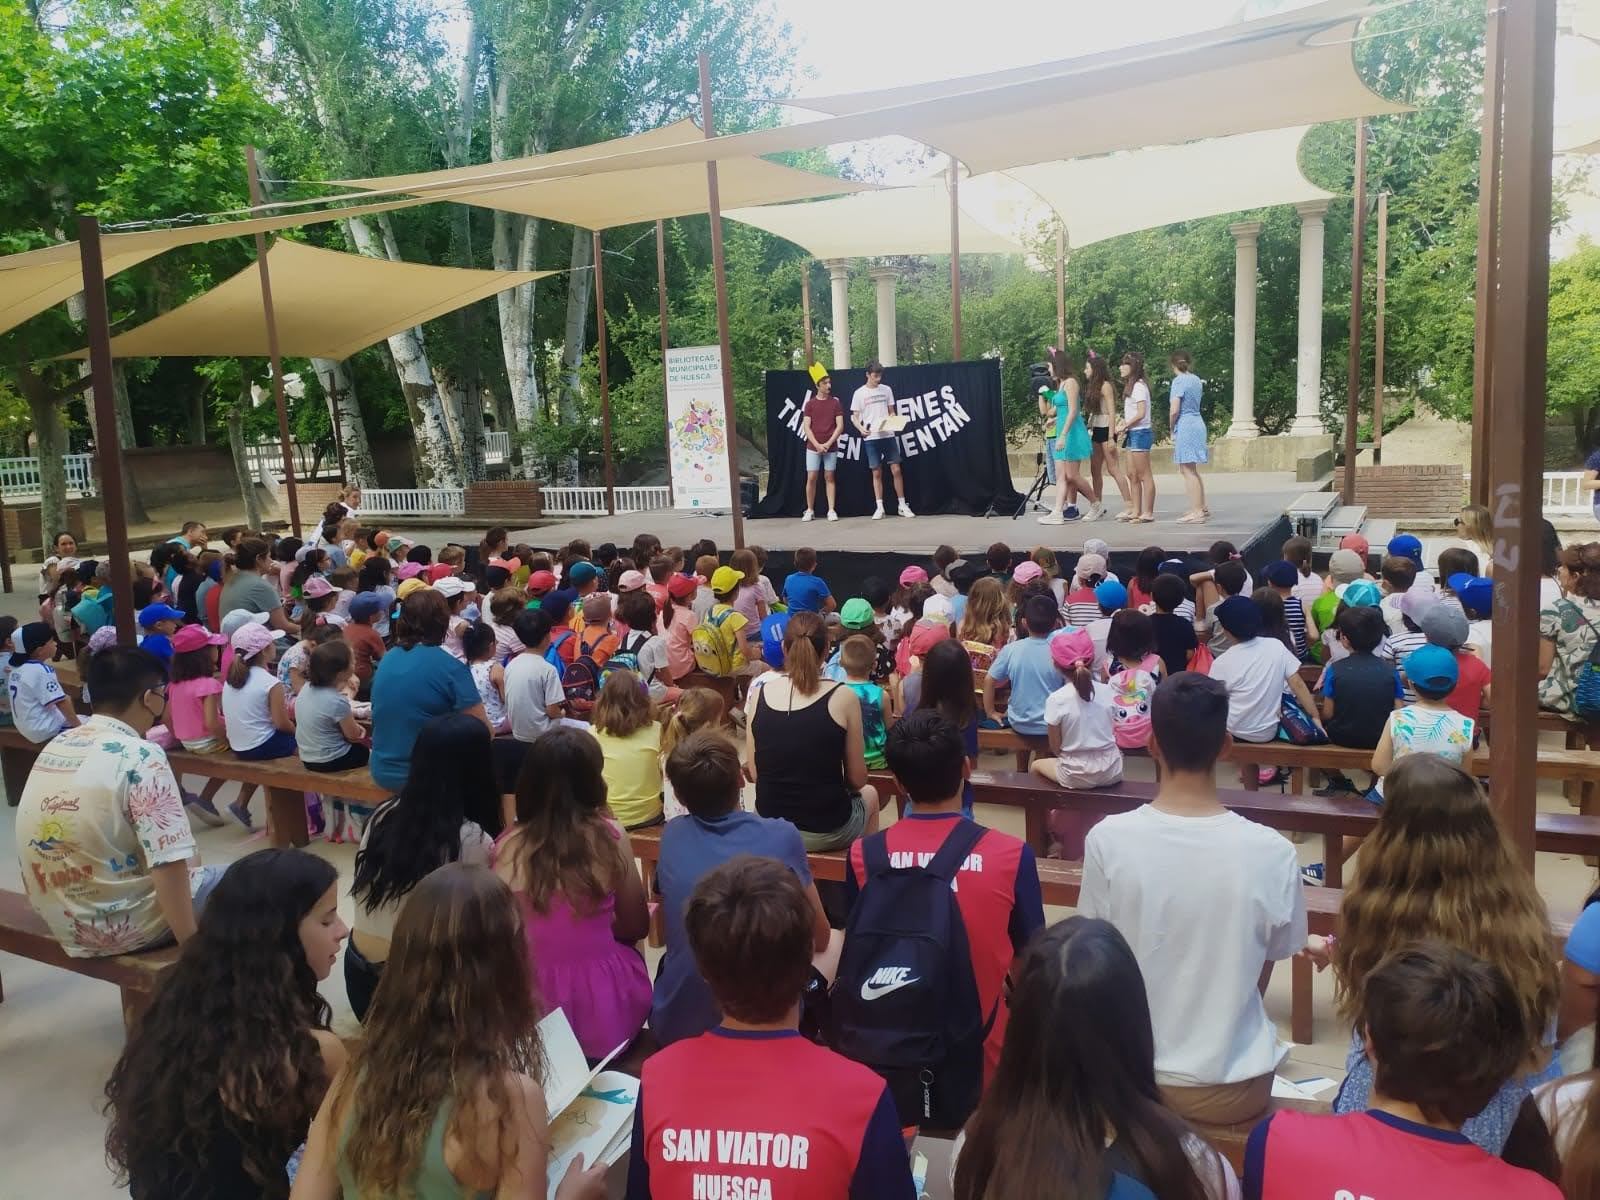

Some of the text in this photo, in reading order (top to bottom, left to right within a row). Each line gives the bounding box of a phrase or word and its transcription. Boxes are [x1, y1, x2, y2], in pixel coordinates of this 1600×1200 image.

[669, 355, 715, 364] BIBLIOTECAS
[669, 363, 718, 373] MUNICIPALES
[681, 373, 711, 381] HUESCA
[888, 851, 913, 869] AN
[870, 967, 911, 985] NIKE
[662, 1128, 810, 1170] SAN VIATOR
[692, 1173, 773, 1200] HUESCA
